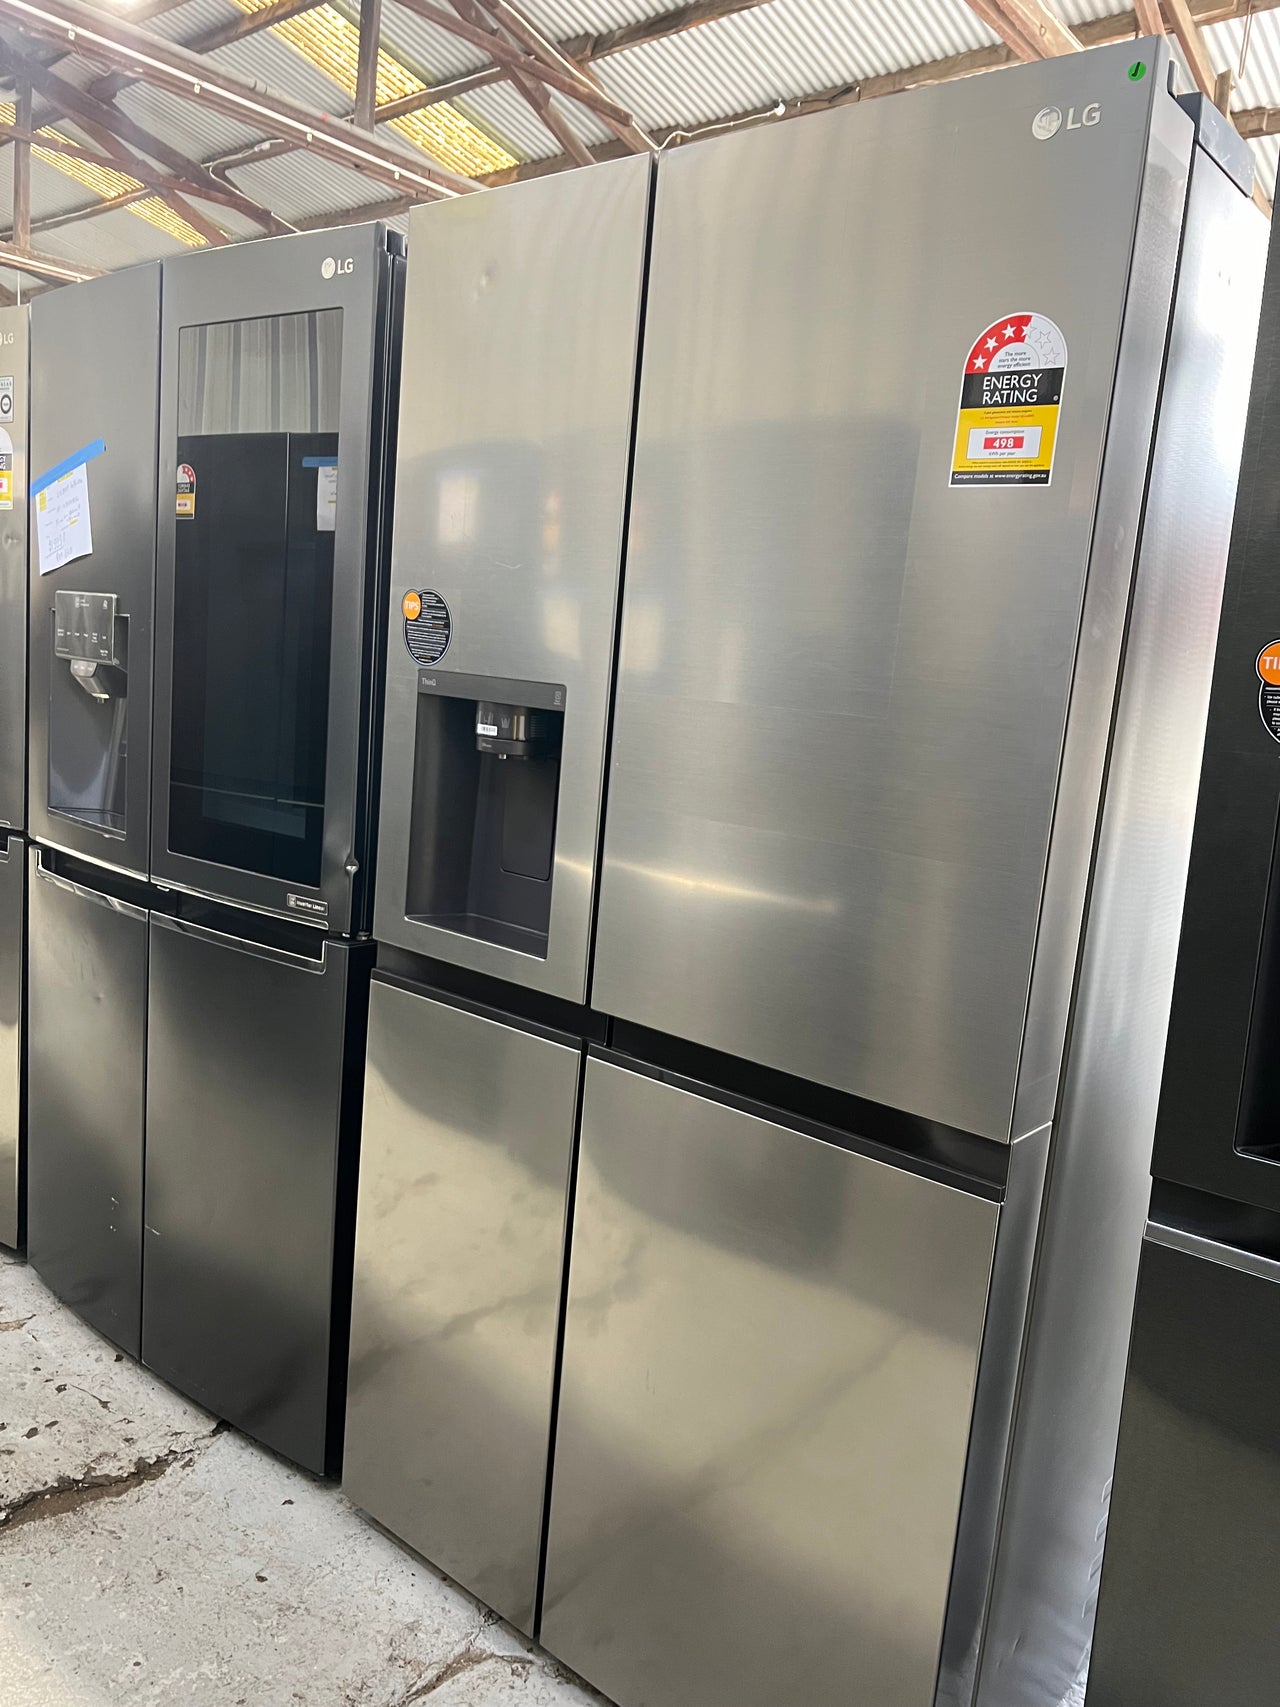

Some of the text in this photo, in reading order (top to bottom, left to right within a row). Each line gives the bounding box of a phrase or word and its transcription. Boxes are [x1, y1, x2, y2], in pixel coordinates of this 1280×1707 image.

[1066, 102, 1102, 130] LG
[337, 258, 354, 275] LG
[3, 332, 14, 345] LG
[983, 373, 1043, 389] ENERGY
[982, 389, 1038, 405] RATING
[993, 437, 1014, 449] 498
[405, 601, 419, 610] TIPS
[421, 677, 437, 686] ThinQ
